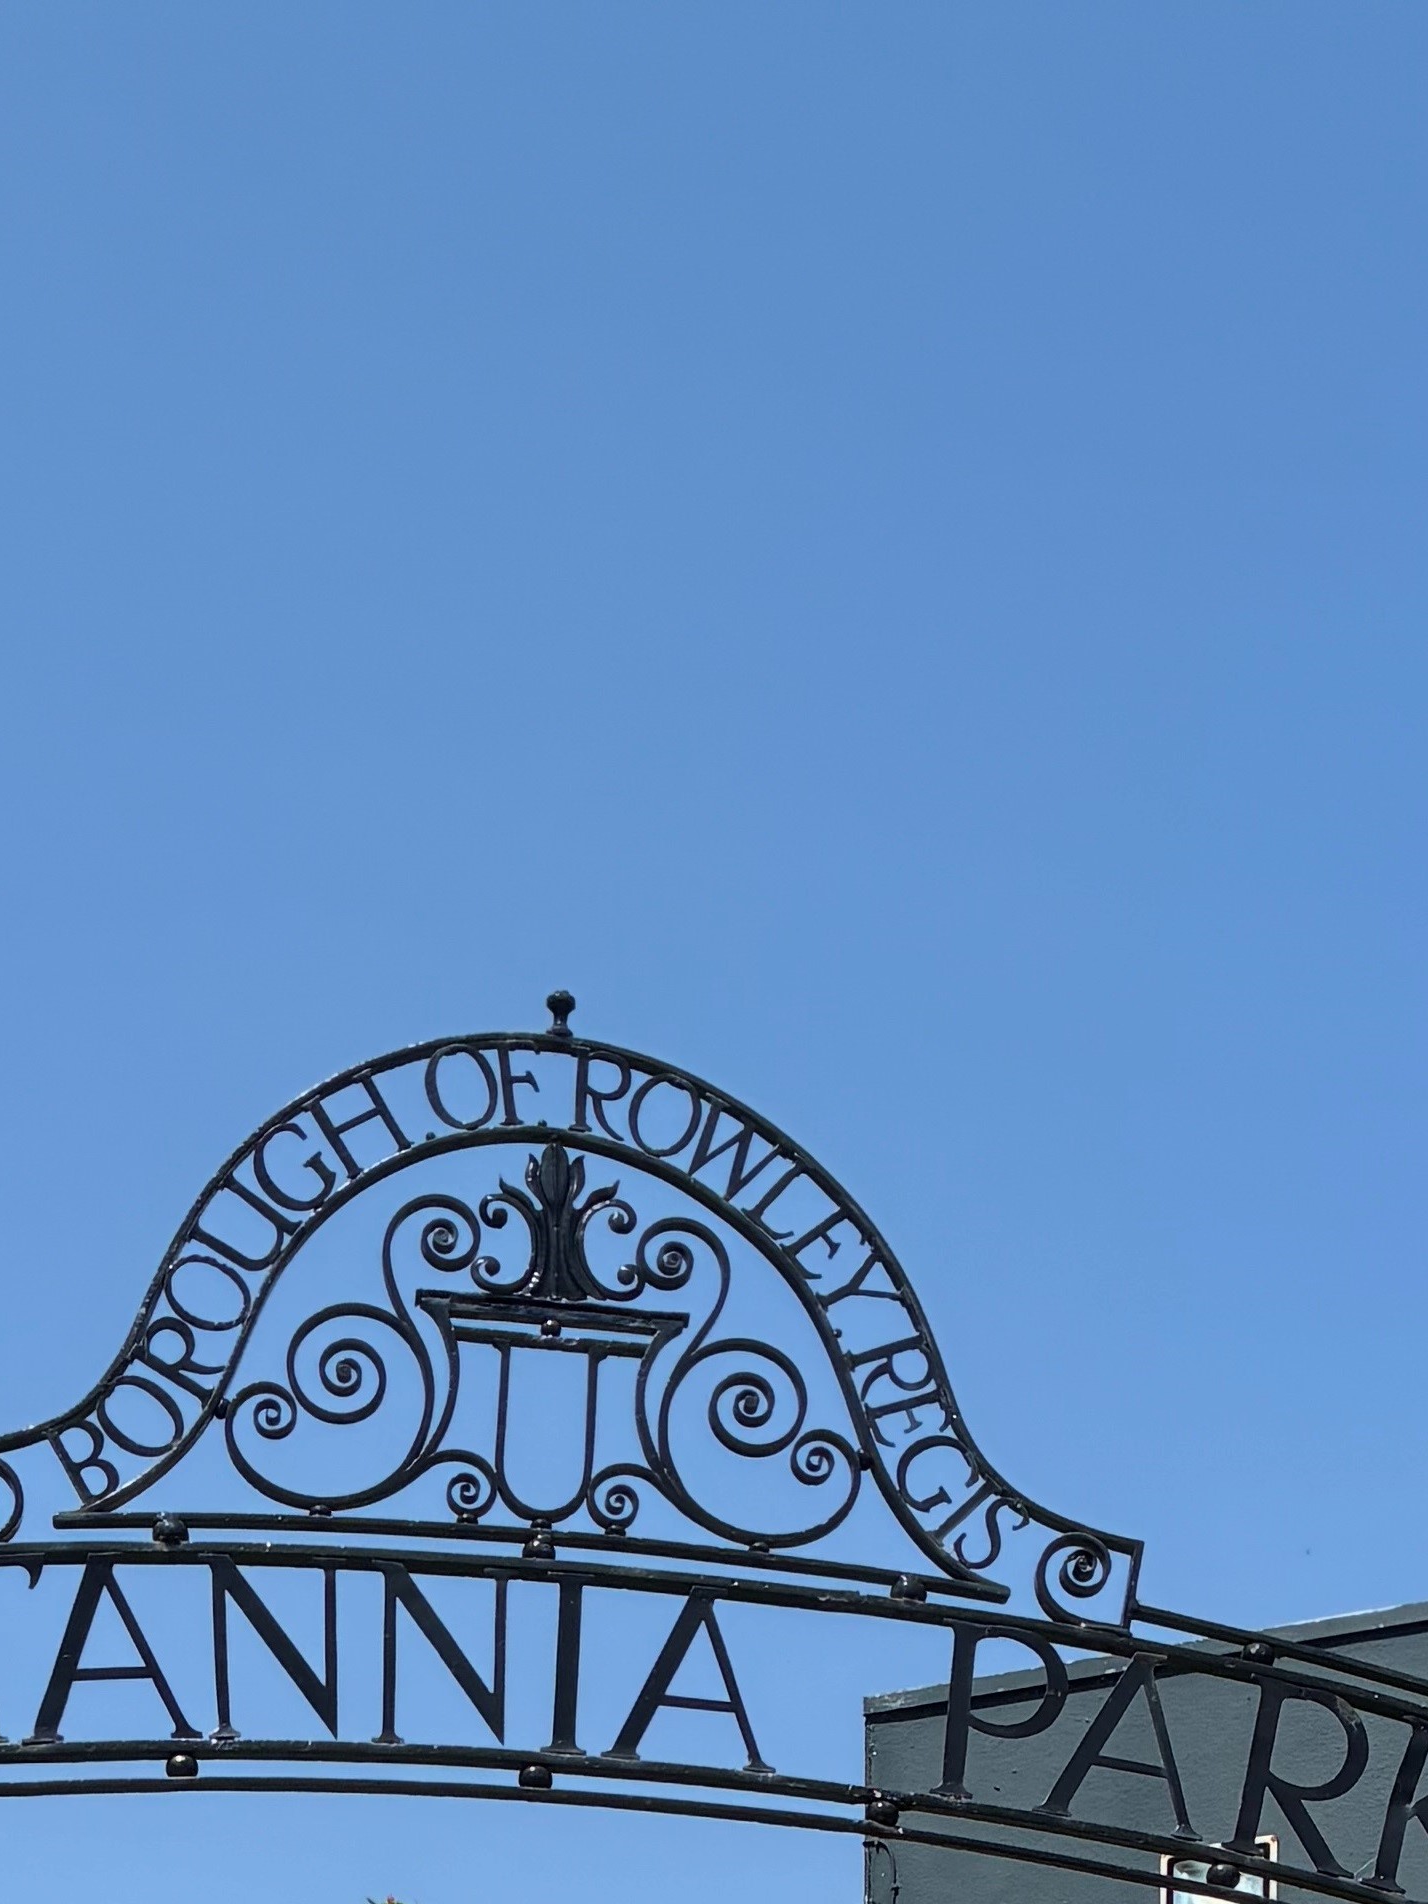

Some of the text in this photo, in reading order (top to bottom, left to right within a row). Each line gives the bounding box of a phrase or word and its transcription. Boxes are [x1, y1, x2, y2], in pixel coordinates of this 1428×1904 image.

[45, 1040, 1030, 1570] BOROUGH OF ROWLEY REGIS
